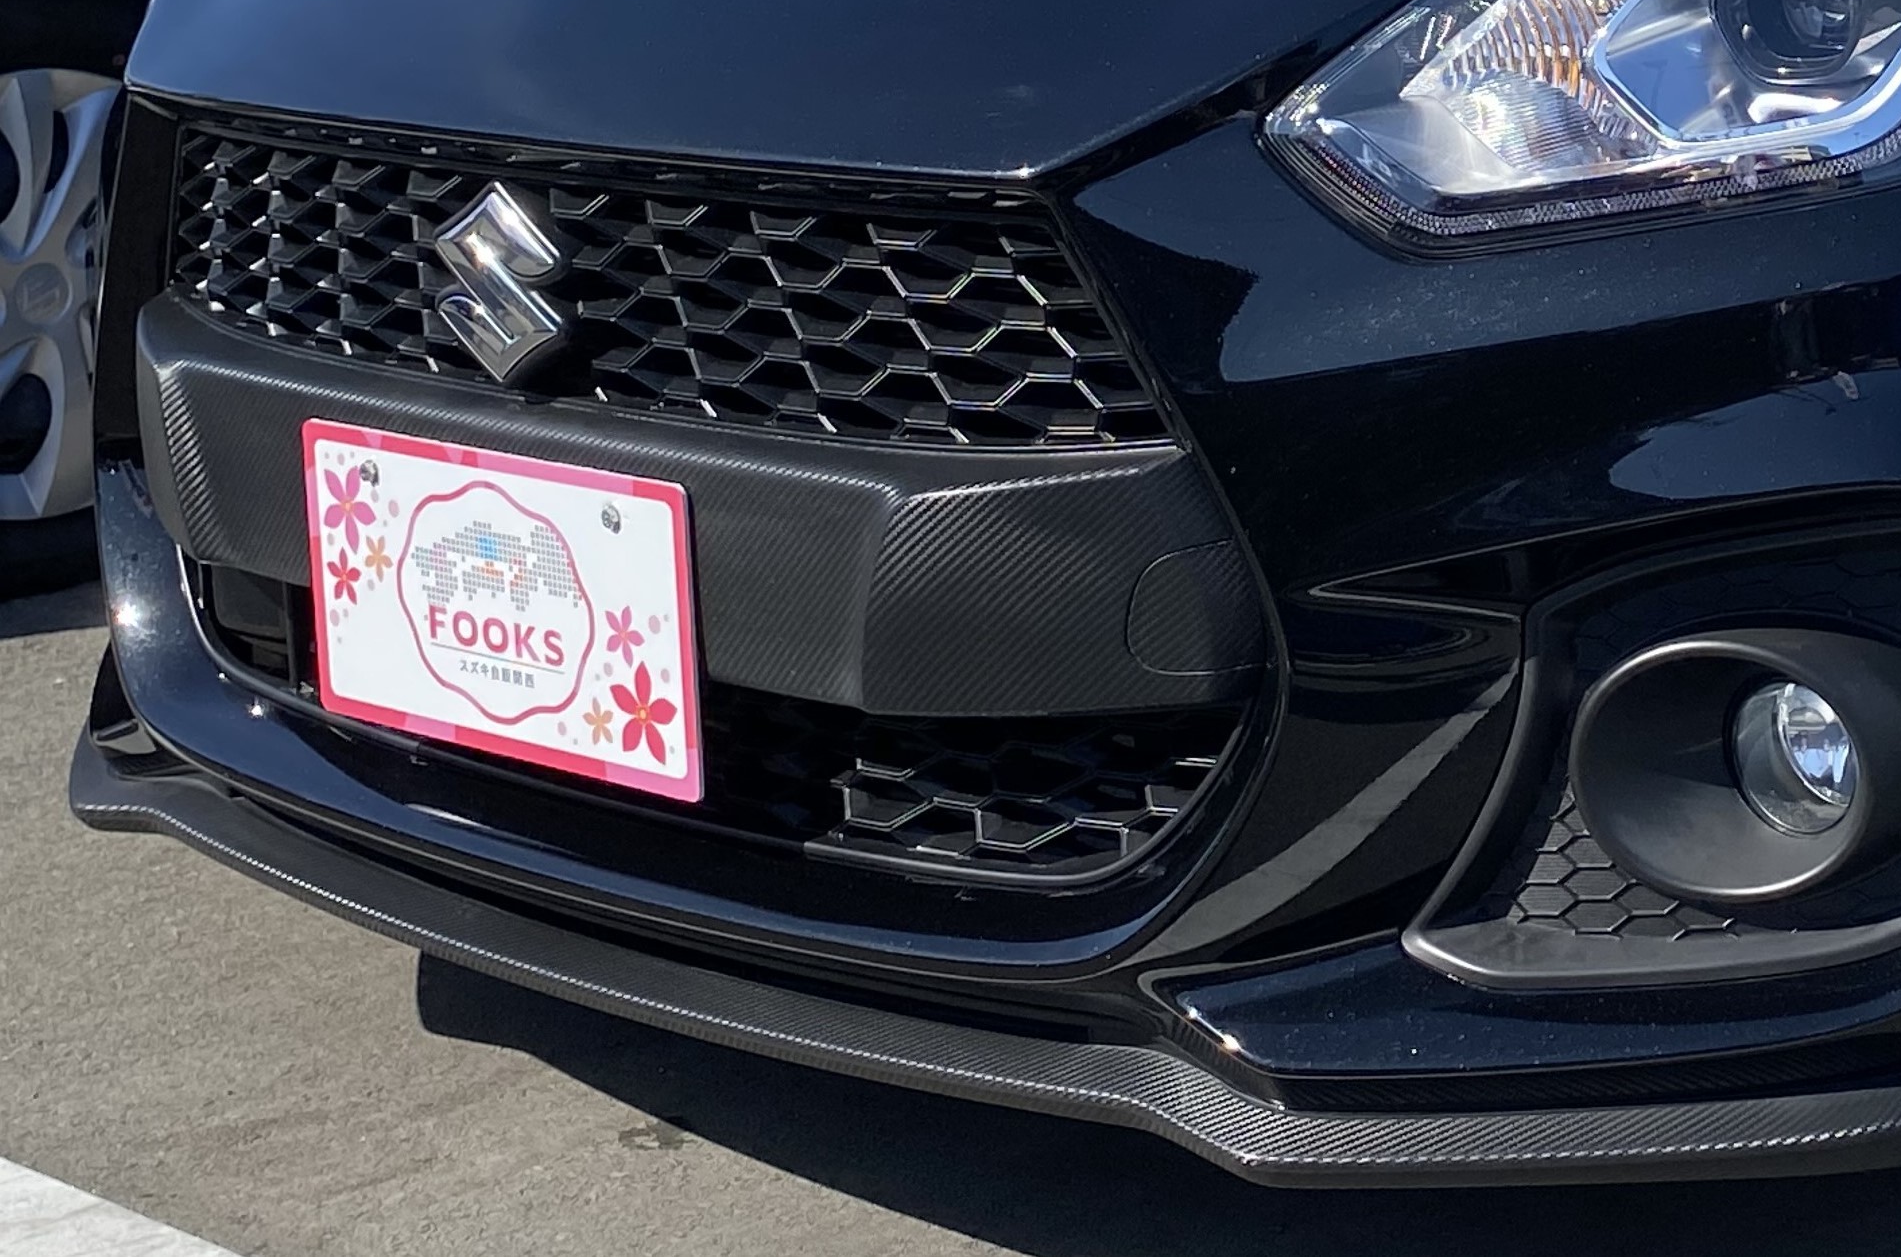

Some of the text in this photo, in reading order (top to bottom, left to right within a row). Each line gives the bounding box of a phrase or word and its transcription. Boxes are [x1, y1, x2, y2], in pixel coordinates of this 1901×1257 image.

[428, 603, 564, 666] FOOKS
[459, 659, 535, 689] スズキ自販関西
